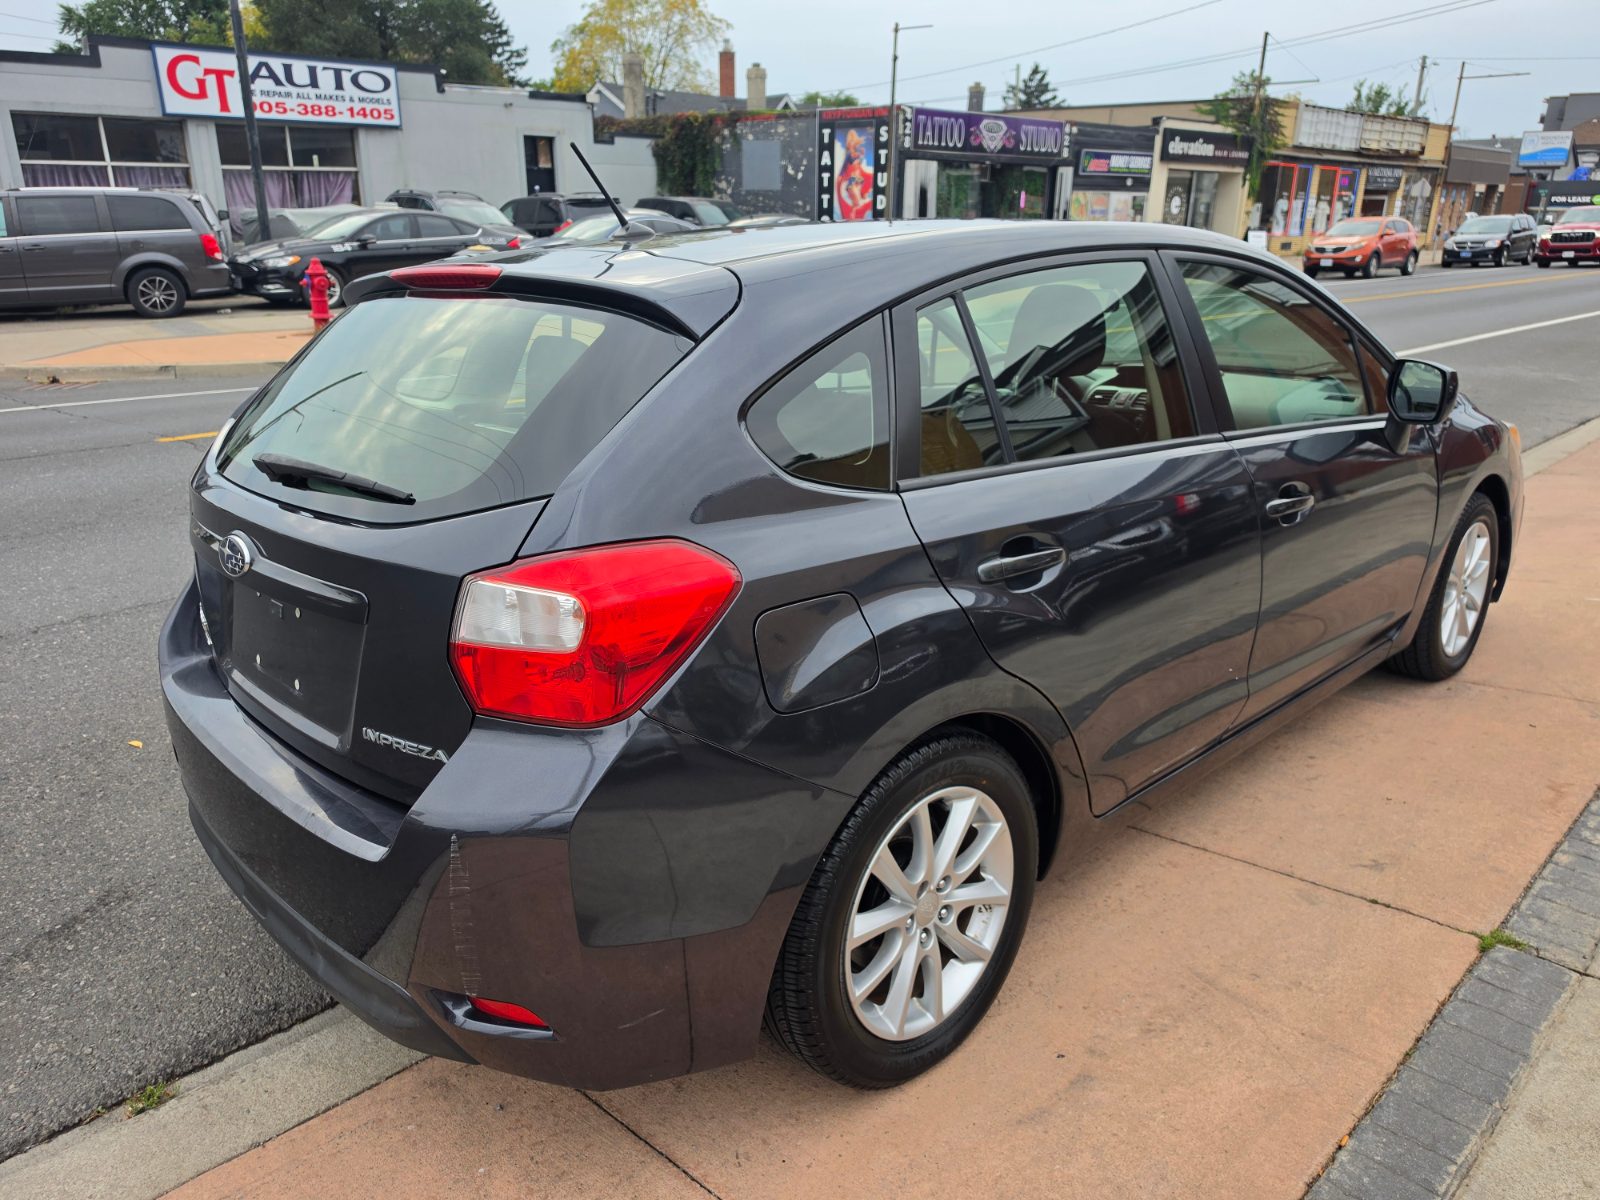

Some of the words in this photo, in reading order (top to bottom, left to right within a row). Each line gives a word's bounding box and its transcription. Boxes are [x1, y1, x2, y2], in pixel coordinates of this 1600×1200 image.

[166, 54, 235, 113] GT
[250, 61, 392, 94] AUTO
[260, 89, 293, 99] REPAIR
[296, 92, 313, 101] ALL
[315, 93, 346, 102] MAKES
[358, 97, 392, 106] MODELS
[917, 115, 966, 148] TATTOO
[1020, 124, 1061, 153] STUDIO
[1168, 136, 1215, 157] elevation
[1551, 195, 1567, 203] FOR
[1567, 195, 1592, 204] LEASE
[362, 727, 449, 763] IMPREZA
